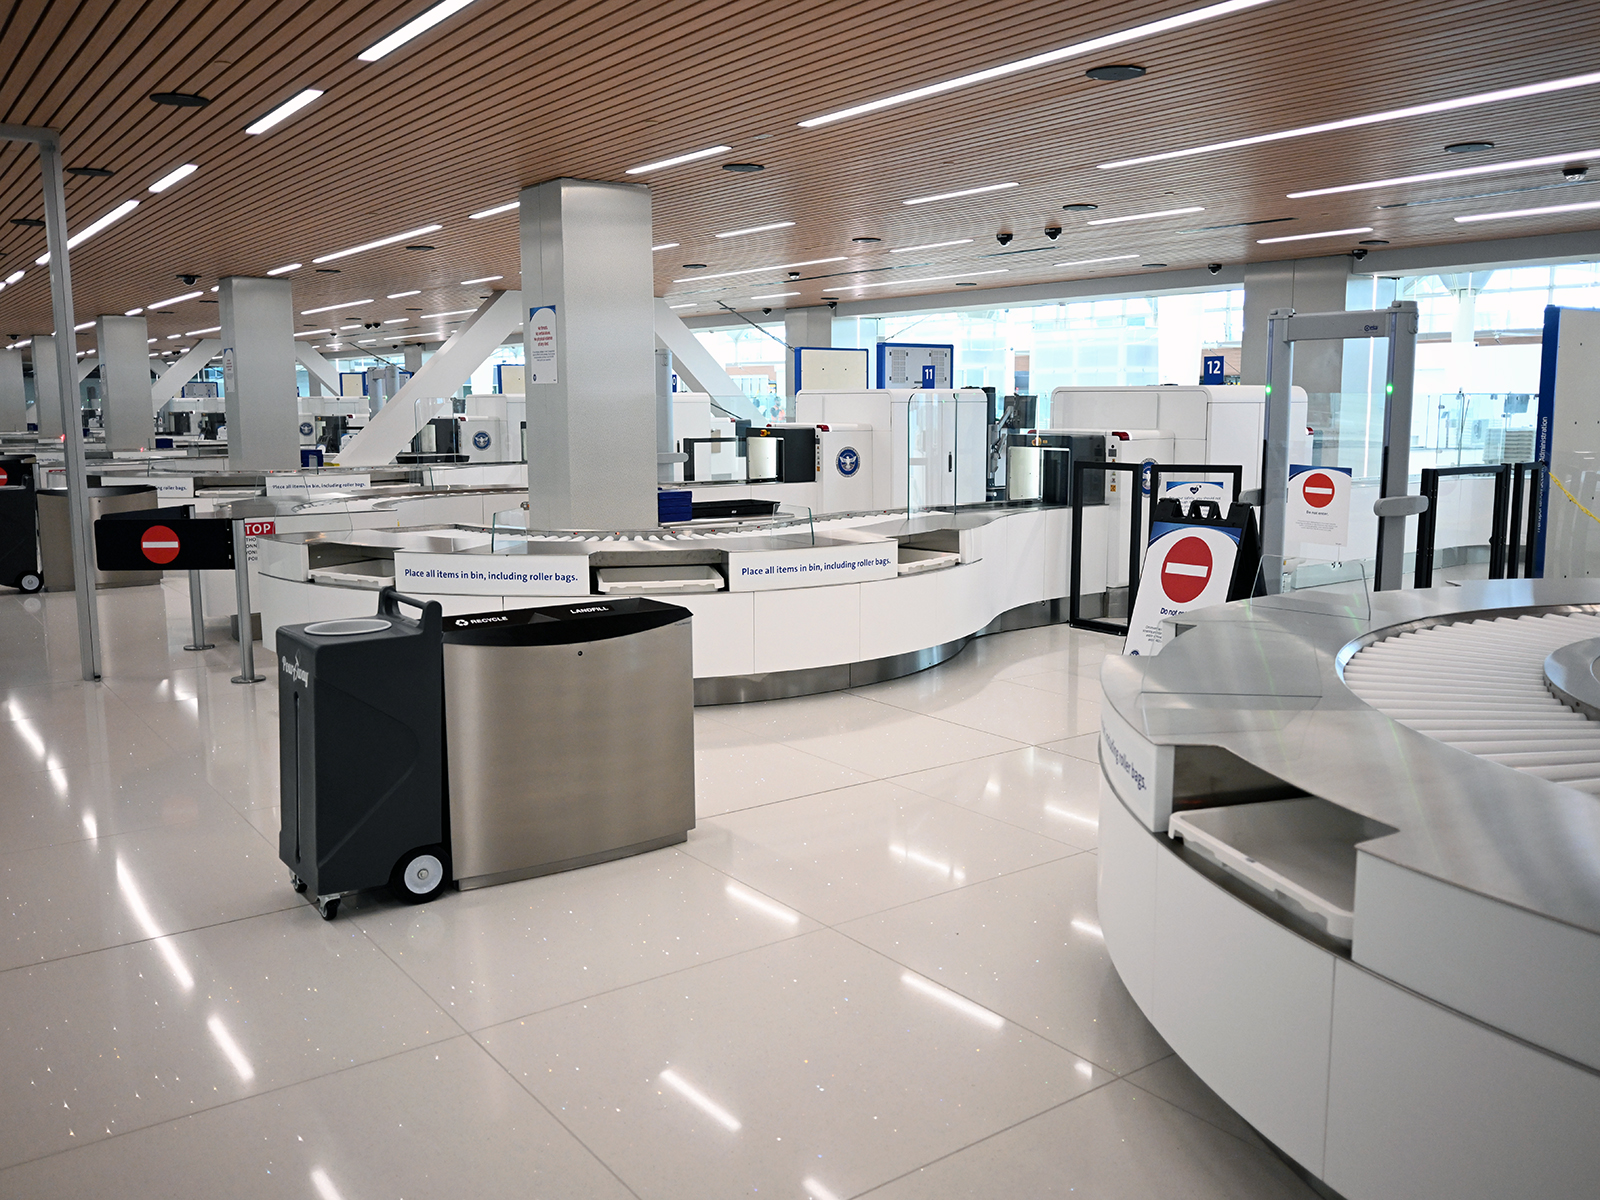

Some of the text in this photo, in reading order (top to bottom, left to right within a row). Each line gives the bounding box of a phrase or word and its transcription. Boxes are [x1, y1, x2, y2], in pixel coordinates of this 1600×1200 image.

[1207, 360, 1221, 374] 12
[925, 368, 933, 380] 11
[245, 523, 271, 535] TOP
[742, 558, 892, 576] Place all items in bin, including roller bags.
[405, 568, 578, 583] Place all items in bin, including roller bags.
[570, 606, 609, 614] LANDFILL
[470, 616, 508, 625] RECYCLE
